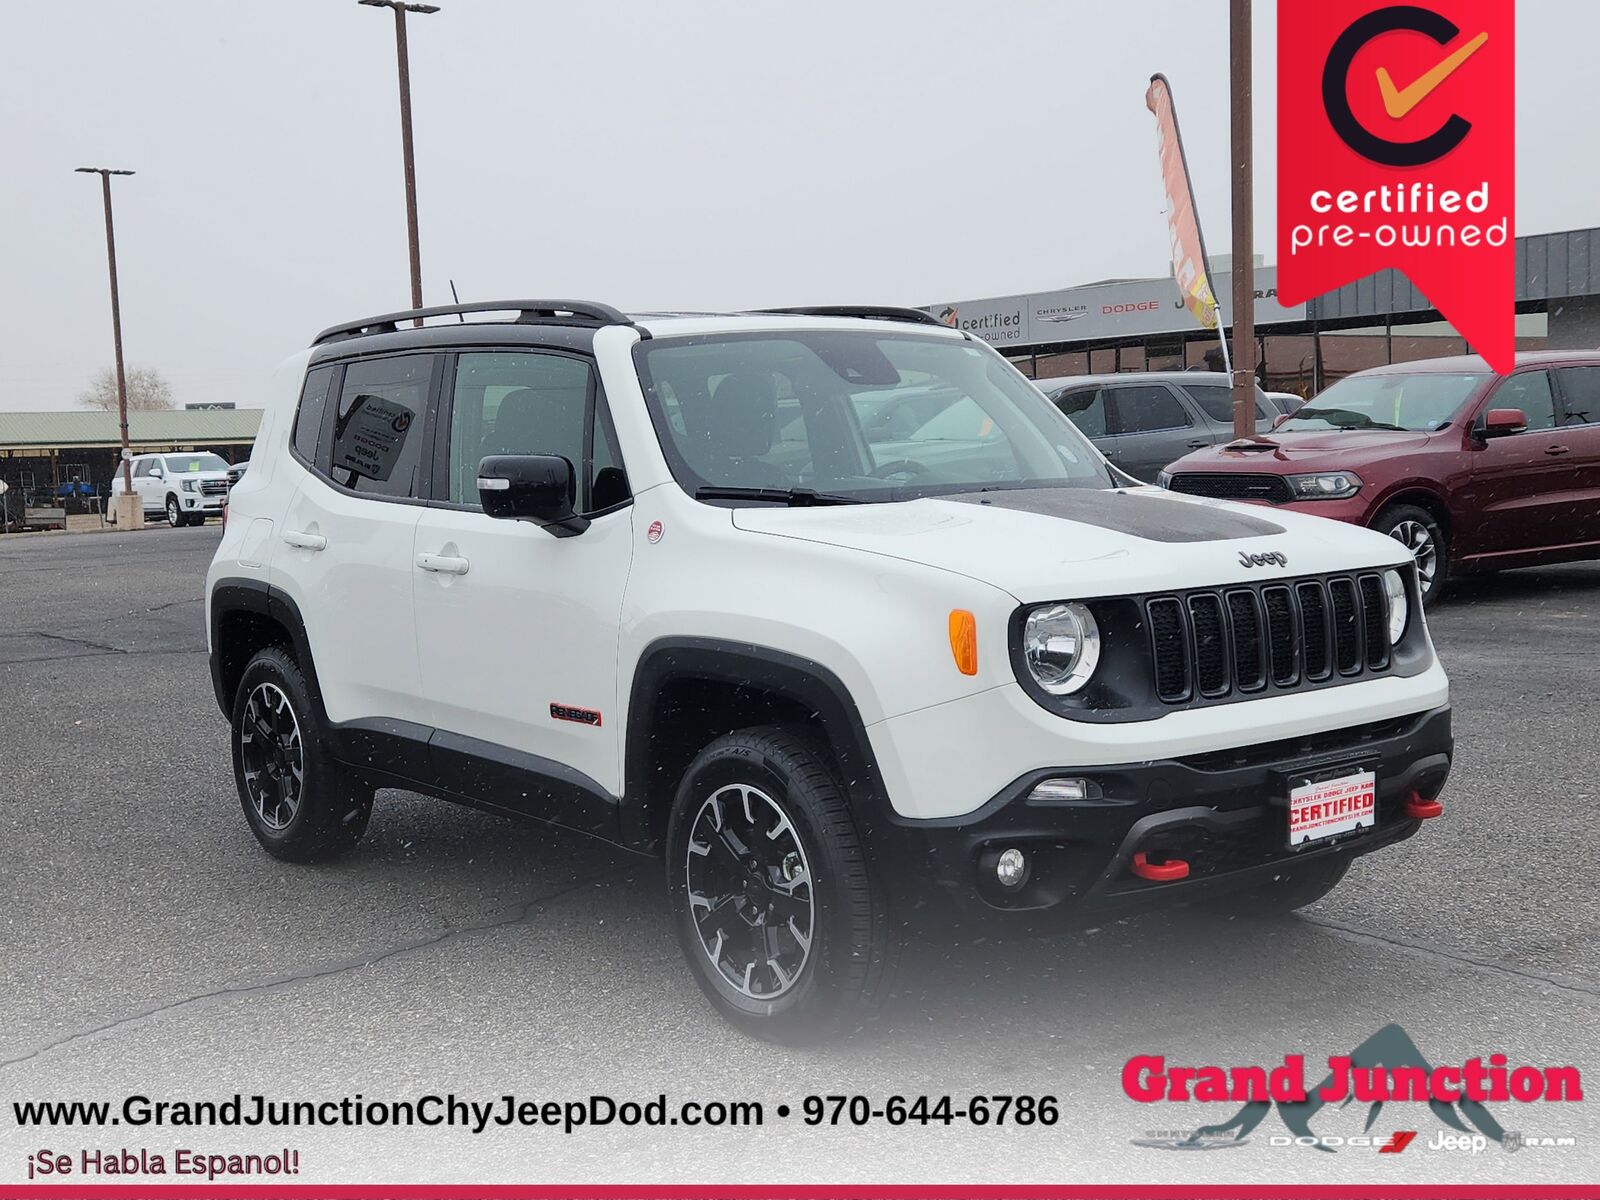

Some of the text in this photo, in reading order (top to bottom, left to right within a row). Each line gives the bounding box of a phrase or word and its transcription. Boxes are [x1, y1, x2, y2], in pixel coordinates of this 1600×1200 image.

[1036, 304, 1088, 316] CHRYSLER
[1102, 301, 1159, 315] DODGE
[962, 311, 1020, 331] certified
[1238, 551, 1288, 568] Jeep
[1290, 792, 1374, 825] CERTIFIED
